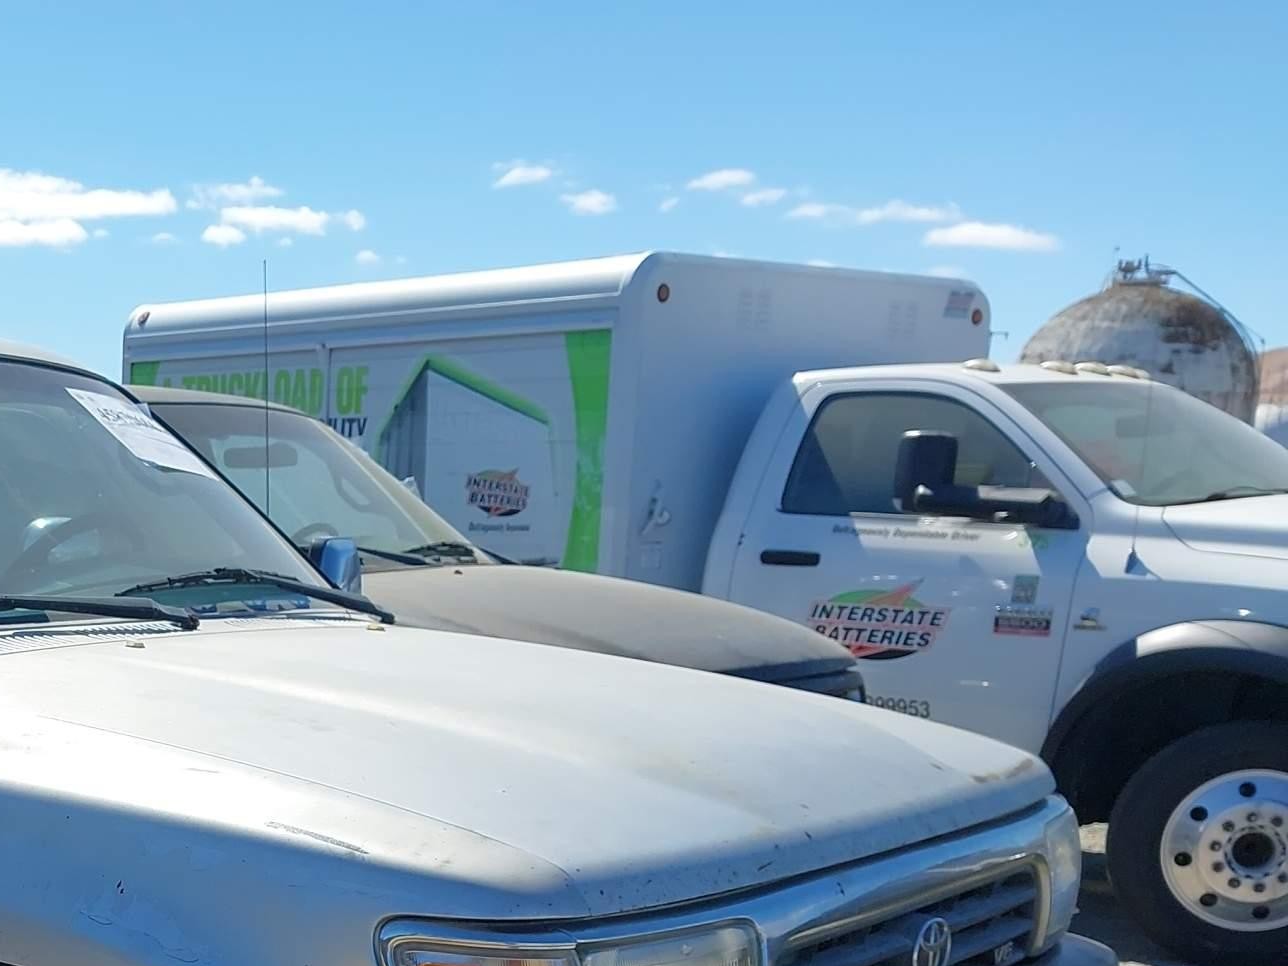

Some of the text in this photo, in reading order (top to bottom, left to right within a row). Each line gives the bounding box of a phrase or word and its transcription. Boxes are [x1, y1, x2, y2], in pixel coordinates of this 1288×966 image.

[182, 366, 369, 415] CKLOAD OF
[466, 474, 530, 497] INTERSTATE
[468, 492, 527, 509] BATTERIES
[811, 604, 945, 627] INTERSTATE
[814, 625, 932, 648] BATTERIES
[994, 942, 1015, 965] V6
